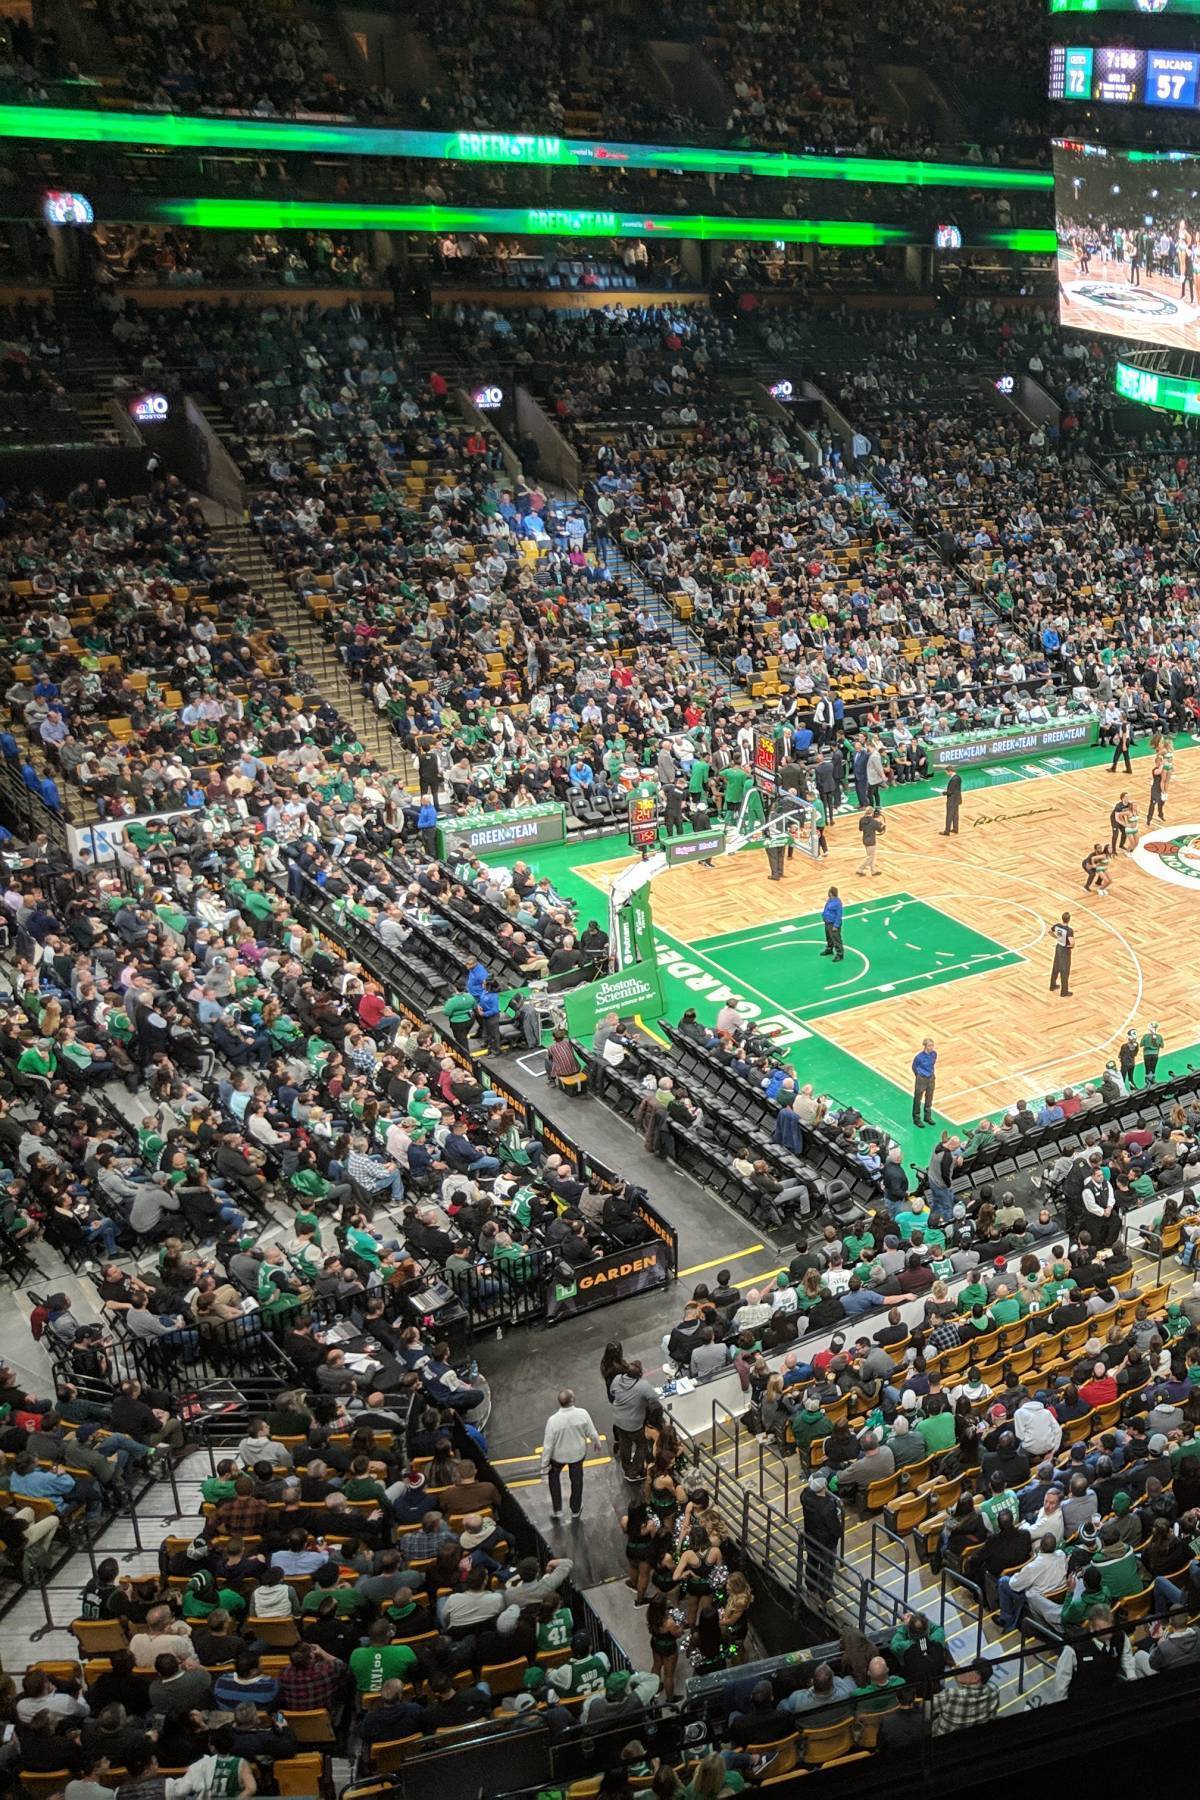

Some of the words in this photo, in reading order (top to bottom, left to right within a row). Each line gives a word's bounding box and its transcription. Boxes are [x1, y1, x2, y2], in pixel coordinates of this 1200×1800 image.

[1106, 51, 1137, 69] 7:56
[1153, 59, 1193, 71] PELICANS
[1157, 75, 1185, 99] 57
[458, 132, 511, 157] GREEN
[517, 134, 561, 160] TEAM
[528, 209, 573, 230] GREEN
[579, 212, 615, 232] TEAM
[1002, 376, 1014, 389] 10
[484, 387, 503, 403] 10
[146, 397, 168, 414] 10
[992, 738, 1016, 754] GREEN
[1019, 735, 1037, 750] TEAM
[1043, 730, 1065, 744] GREEN
[1068, 726, 1086, 740] TEAM
[757, 749, 774, 770] 24
[939, 746, 964, 763] GREEN
[968, 743, 987, 759] TEAM
[636, 809, 651, 821] 24
[471, 829, 506, 847] GREEN
[510, 823, 539, 840] TEAM
[623, 922, 631, 955] Putnam
[595, 981, 651, 1006] Scientific
[600, 977, 643, 995] Boston
[491, 1081, 527, 1117] GARDEN
[543, 1126, 578, 1162] GARDEN
[580, 1254, 657, 1290] GARDEN
[991, 1495, 1015, 1514] GREEN
[548, 1625, 567, 1646] 41
[581, 1669, 598, 1681] BIRD
